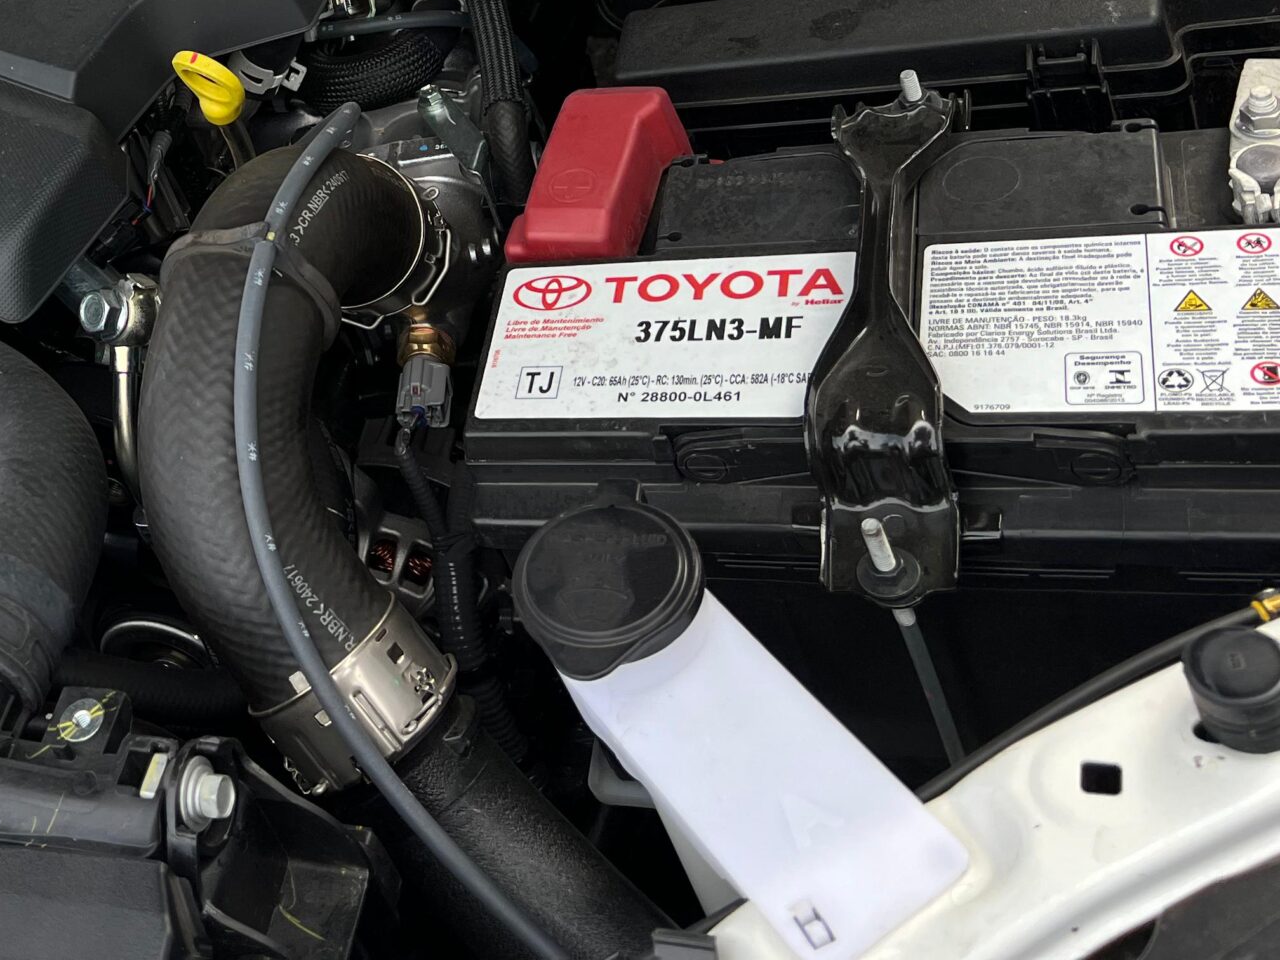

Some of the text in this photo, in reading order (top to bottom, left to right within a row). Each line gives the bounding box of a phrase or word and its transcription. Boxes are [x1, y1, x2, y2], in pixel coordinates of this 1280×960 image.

[605, 268, 844, 303] TOYOTA
[635, 316, 803, 343] 375LN3-MF
[525, 371, 555, 394] TJ
[574, 376, 586, 386] 12V
[750, 373, 768, 384] 582A
[640, 391, 742, 403] 28800-0L461
